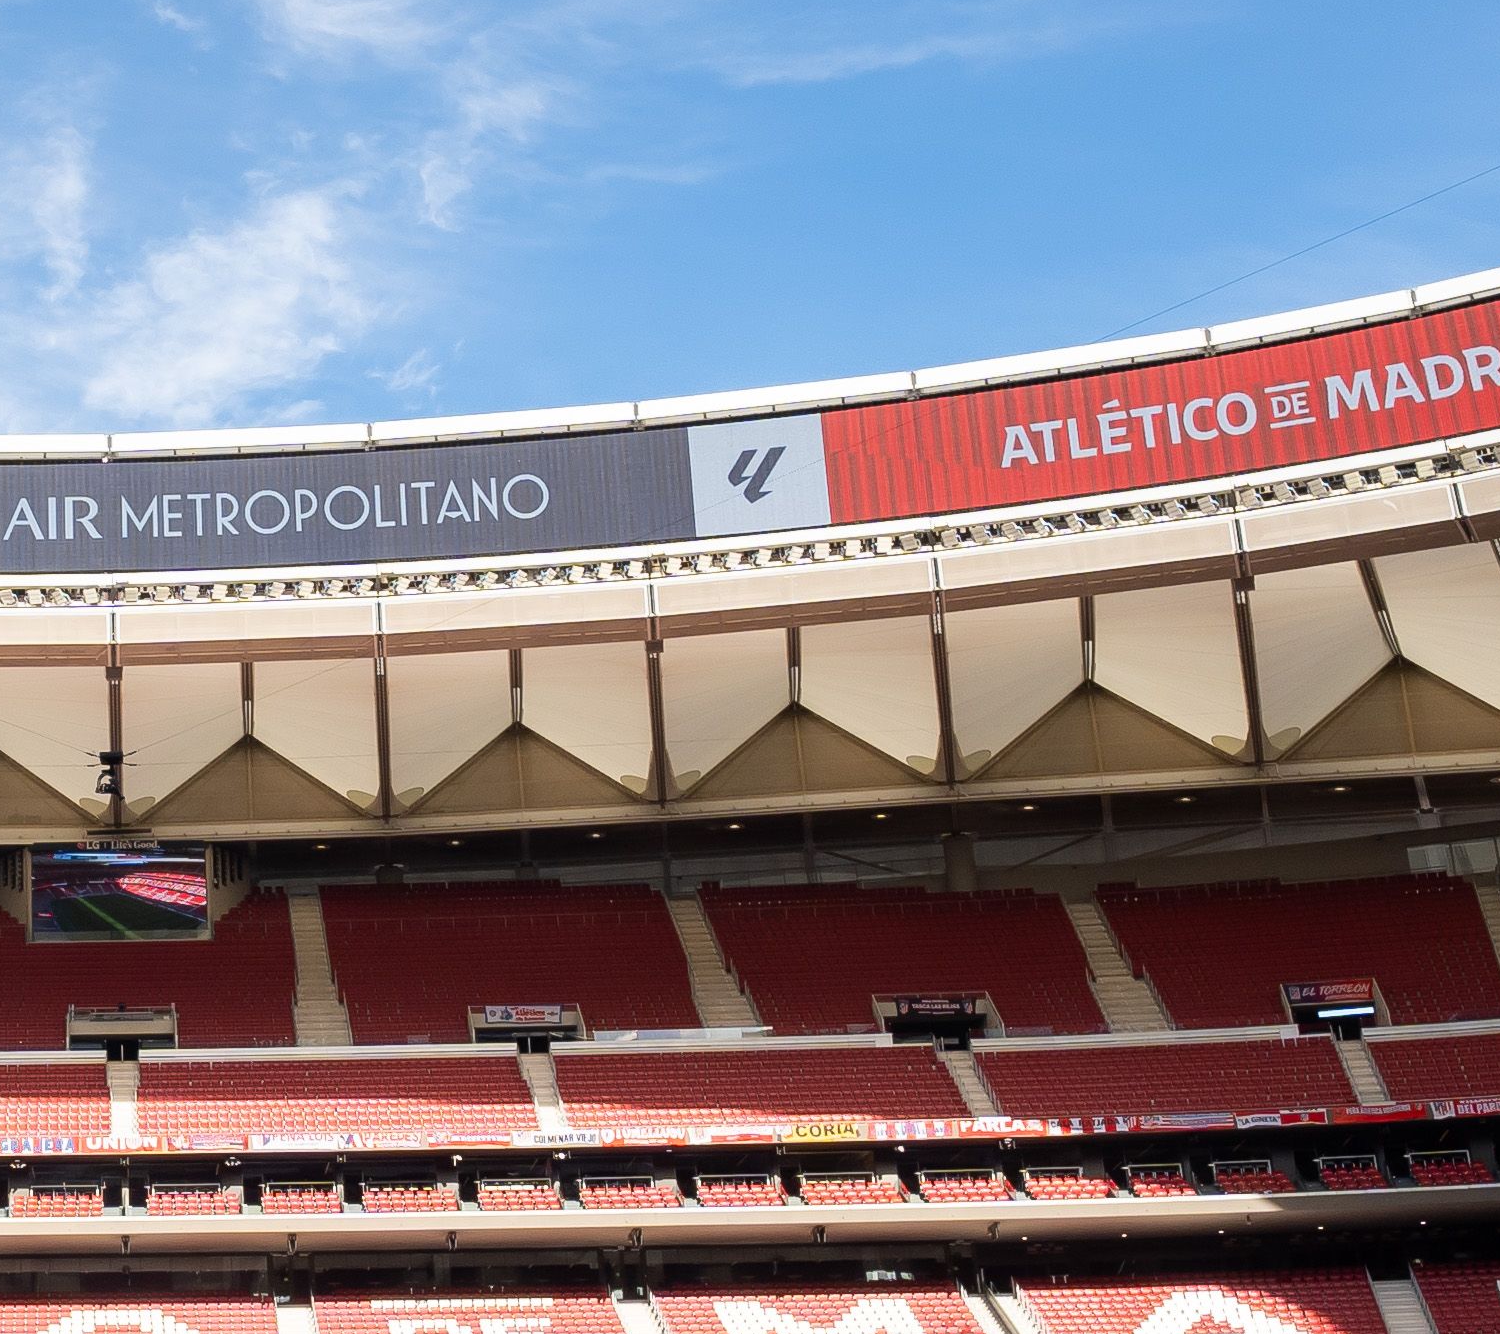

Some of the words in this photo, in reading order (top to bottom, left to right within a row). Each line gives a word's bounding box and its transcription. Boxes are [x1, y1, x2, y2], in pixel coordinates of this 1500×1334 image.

[1000, 392, 1259, 468] ATLÉTICO
[1270, 390, 1309, 420] DE
[3, 494, 104, 542] AIR
[120, 472, 551, 539] METROPOLITANO
[86, 840, 100, 850] LG
[794, 1123, 856, 1139] CORIA
